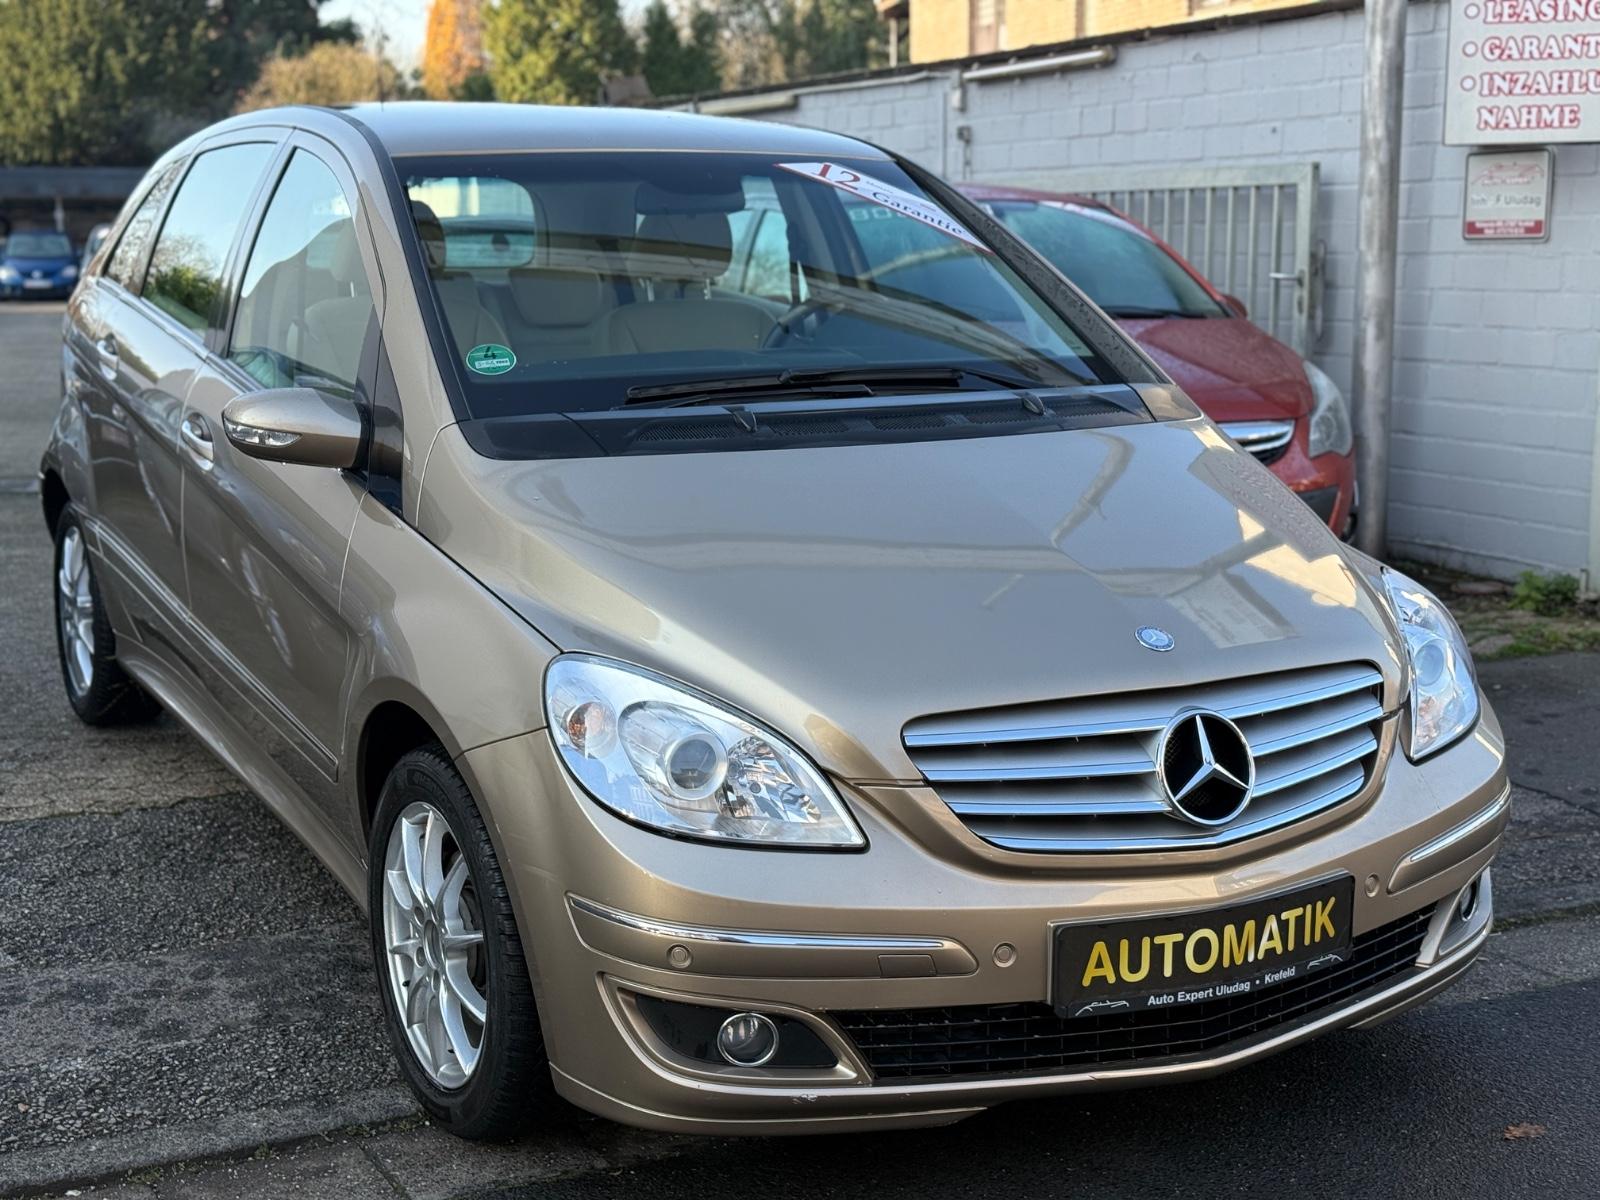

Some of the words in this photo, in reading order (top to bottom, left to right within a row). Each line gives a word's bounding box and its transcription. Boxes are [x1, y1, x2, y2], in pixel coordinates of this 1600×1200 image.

[1483, 0, 1600, 24] LEASING
[1477, 104, 1581, 130] NAHME
[811, 163, 861, 191] 12
[1081, 896, 1336, 987] AUTOMATIK
[1147, 993, 1175, 1006] Auto
[1177, 987, 1213, 1004] Expert
[1215, 980, 1251, 999] Uludag
[1264, 966, 1296, 985] Krefeld
